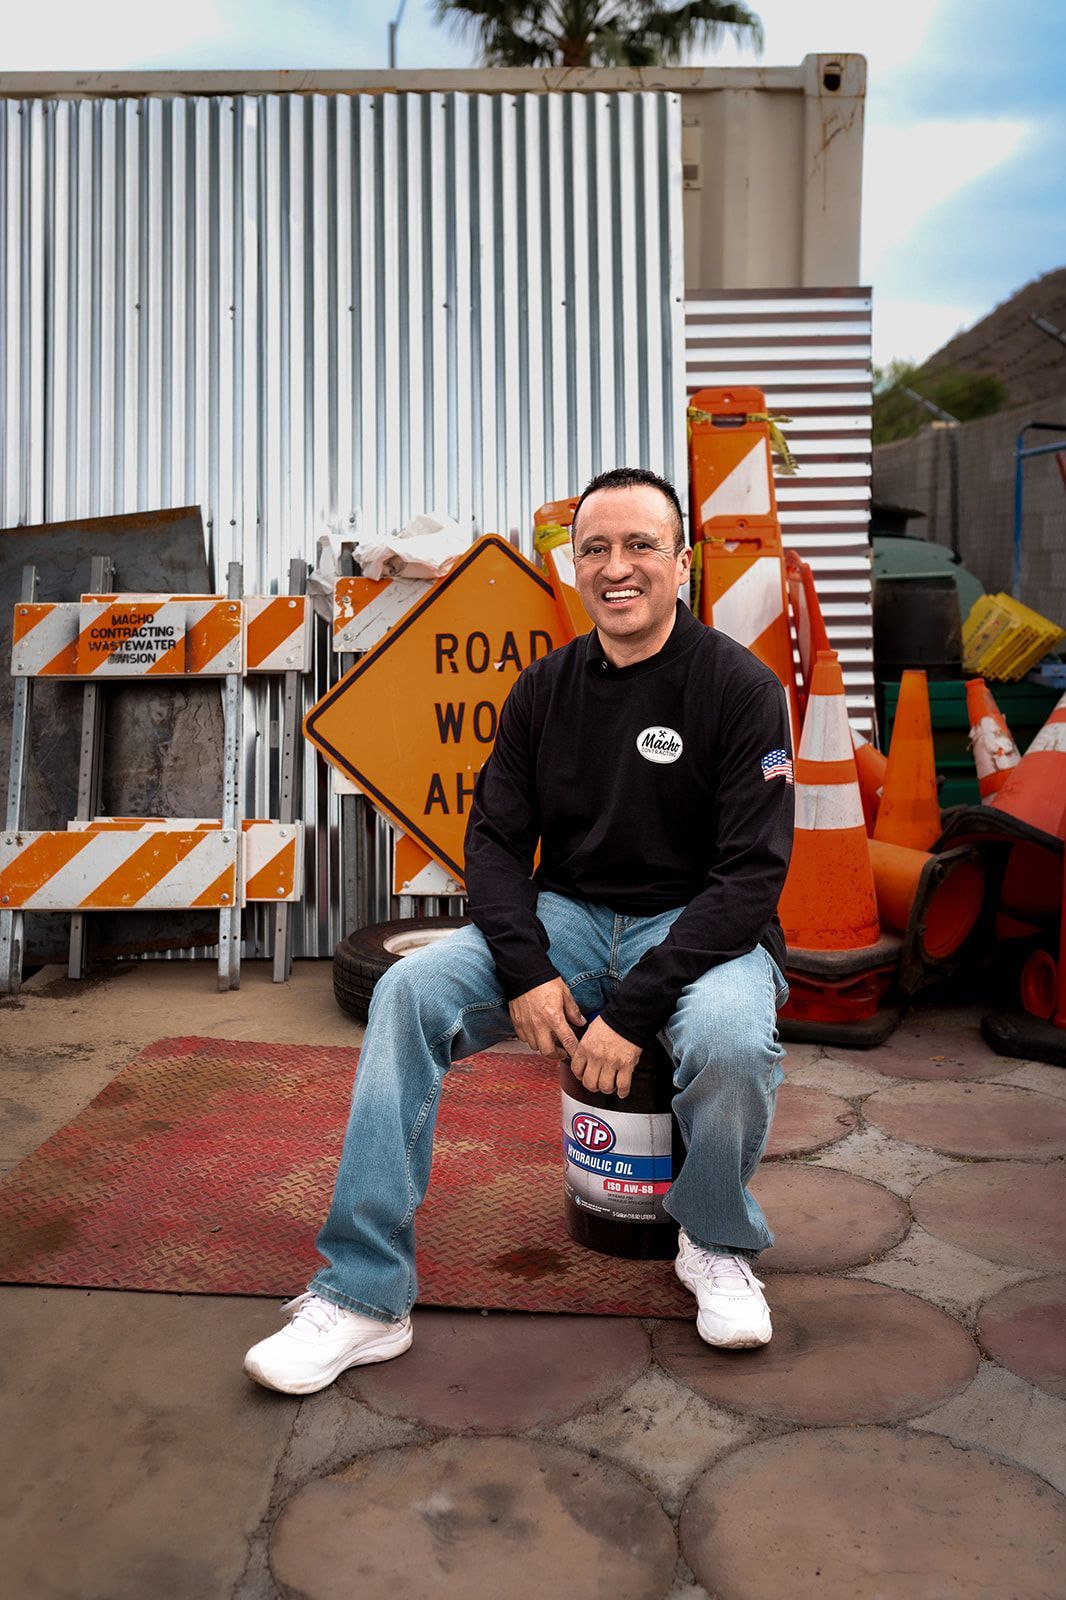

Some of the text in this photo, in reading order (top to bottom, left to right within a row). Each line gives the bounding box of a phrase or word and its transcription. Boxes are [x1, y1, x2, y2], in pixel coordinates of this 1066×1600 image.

[112, 614, 154, 626] MACHO
[91, 626, 174, 639] CONTRACTING
[88, 639, 176, 652] WASTEWATER
[435, 630, 554, 674] ROAD
[434, 701, 498, 744] WO
[641, 732, 681, 753] Macho
[576, 1118, 608, 1146] STP
[567, 1143, 633, 1175] HYDRAULIC OIL
[607, 1181, 654, 1195] ISO AW-68
